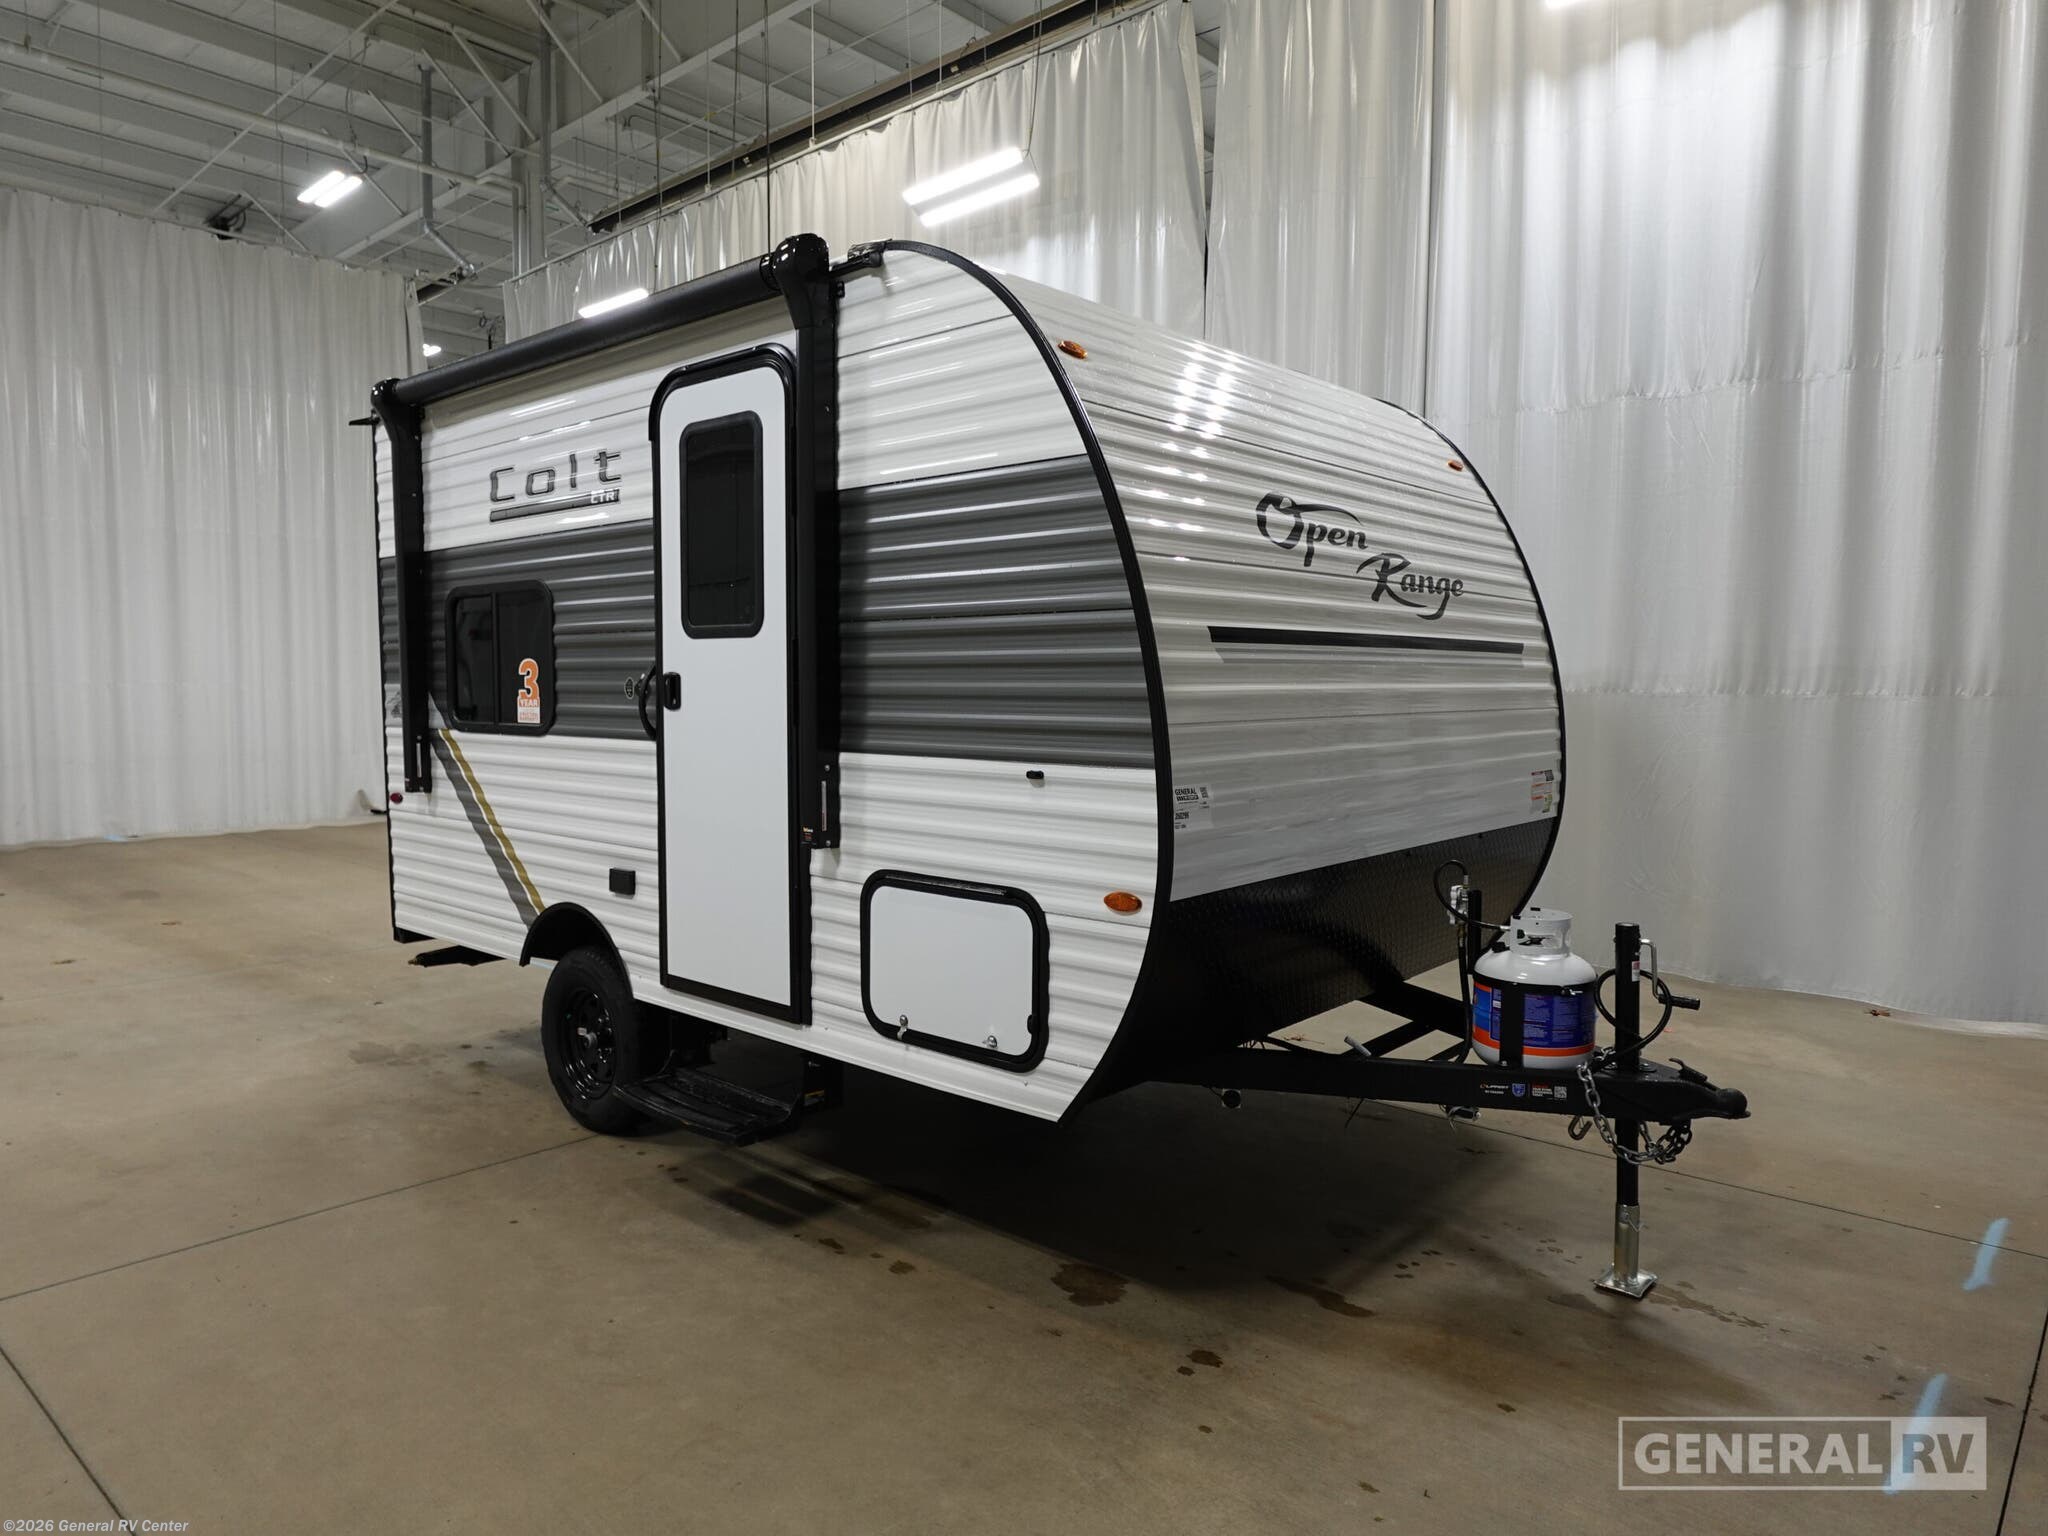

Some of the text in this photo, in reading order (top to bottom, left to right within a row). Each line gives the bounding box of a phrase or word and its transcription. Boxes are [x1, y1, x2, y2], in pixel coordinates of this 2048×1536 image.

[490, 451, 621, 502] Colt
[1256, 491, 1368, 567] Open
[1356, 552, 1464, 621] Range
[519, 659, 539, 700] 3
